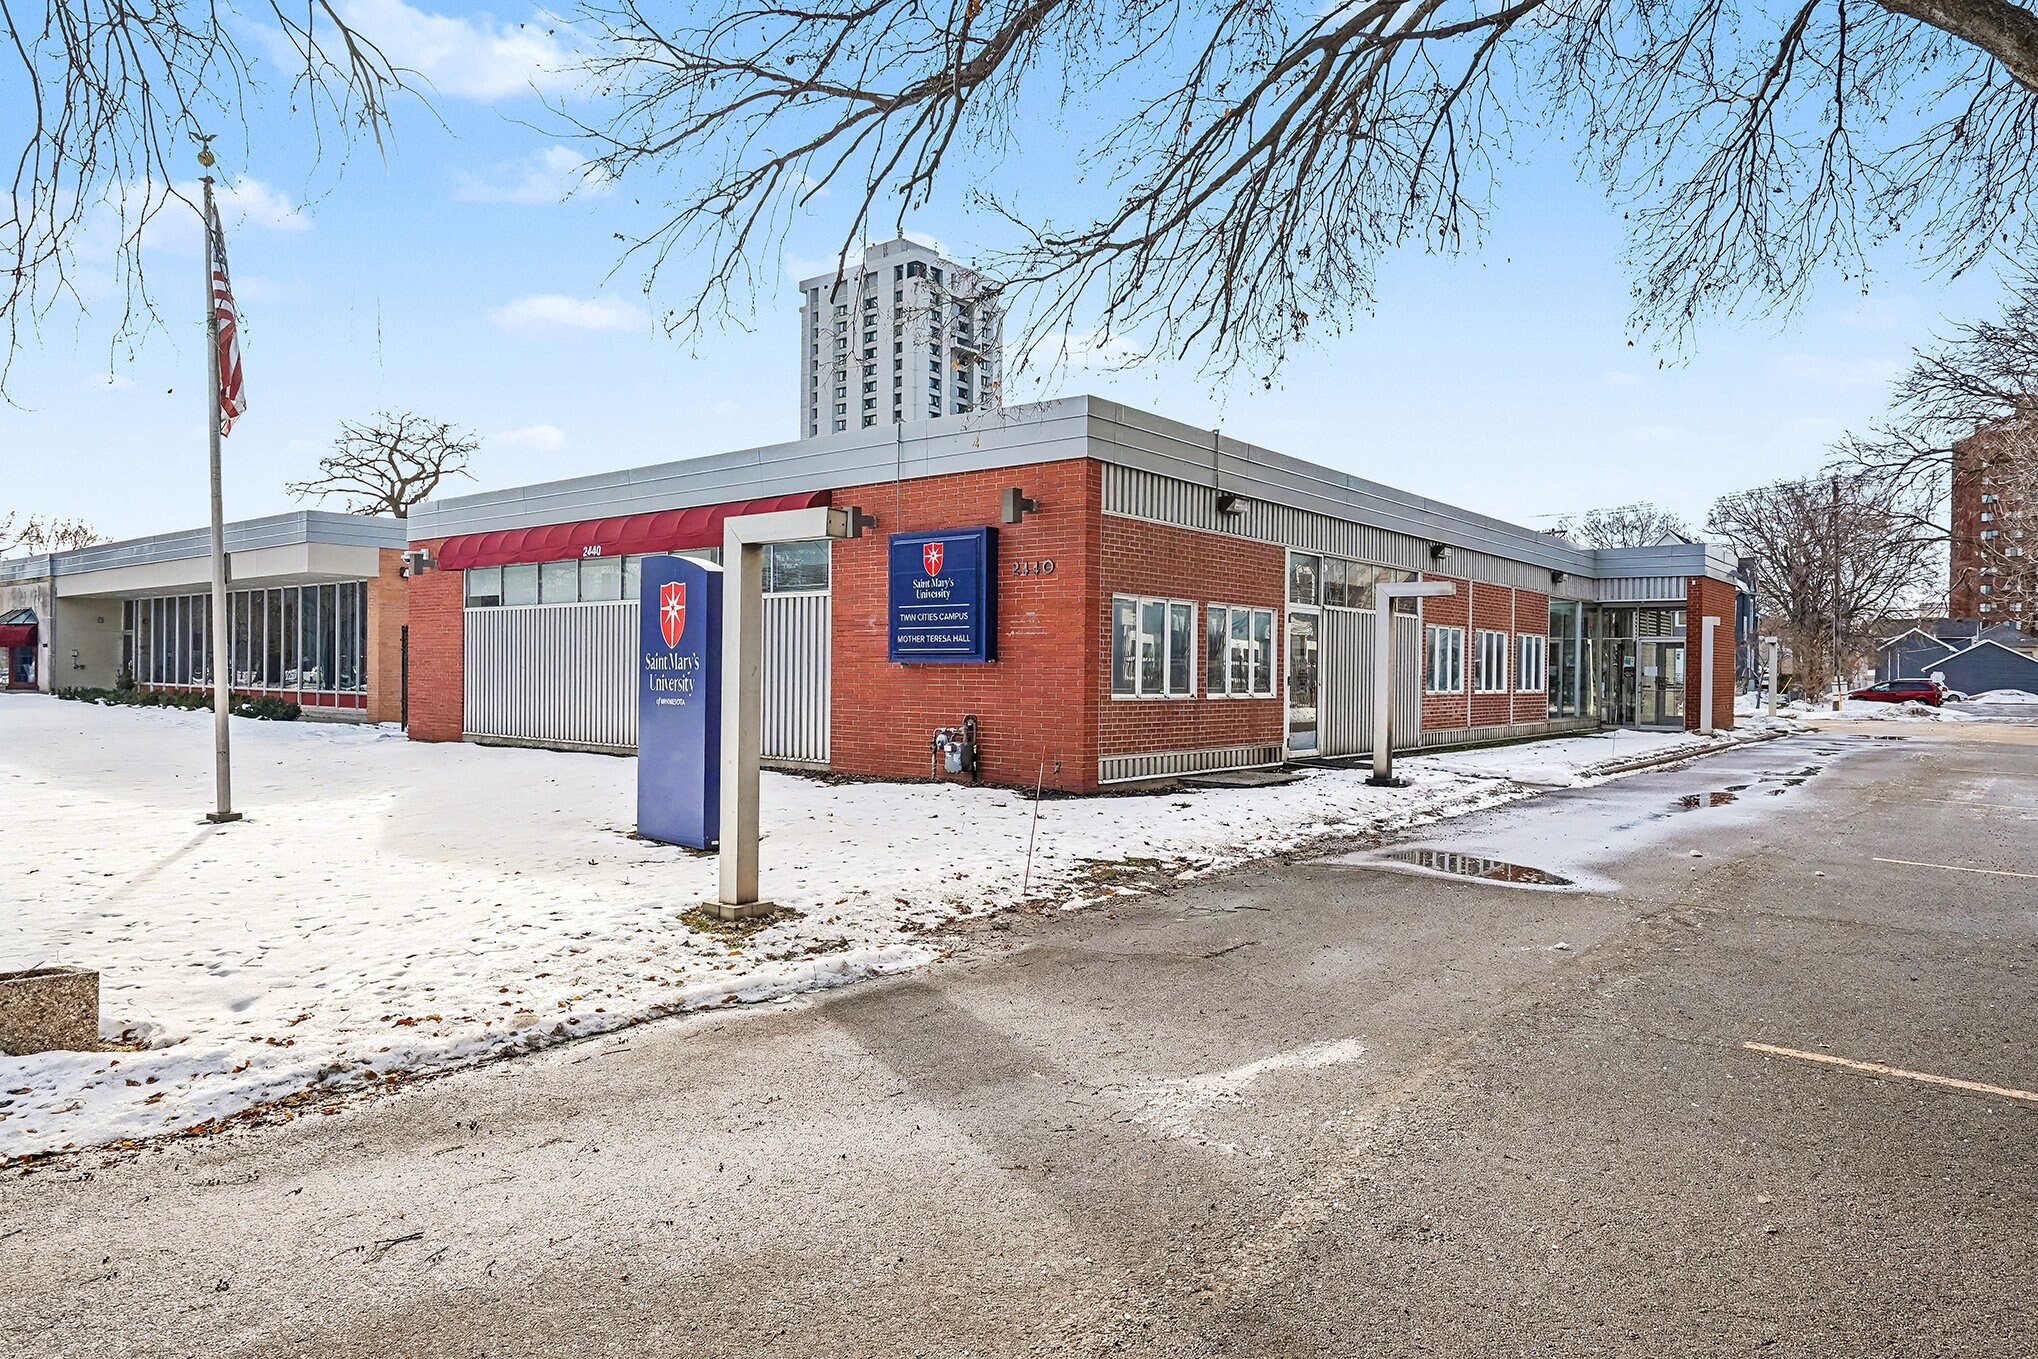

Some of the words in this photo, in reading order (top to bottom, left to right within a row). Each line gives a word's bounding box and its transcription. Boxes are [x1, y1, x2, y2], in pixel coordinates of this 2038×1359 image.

[582, 545, 601, 557] 2440
[912, 578, 930, 589] Saint
[931, 577, 955, 590] Mary's
[916, 589, 951, 600] University
[900, 613, 916, 621] TWIN
[917, 612, 938, 621] CITIES
[939, 612, 969, 621] CAMPUS
[897, 634, 925, 643] MOTHER
[926, 634, 951, 643] TERESA
[952, 634, 971, 643] HALL
[645, 652, 668, 670] Saint
[668, 652, 700, 674] Mary's
[650, 673, 696, 697] University
